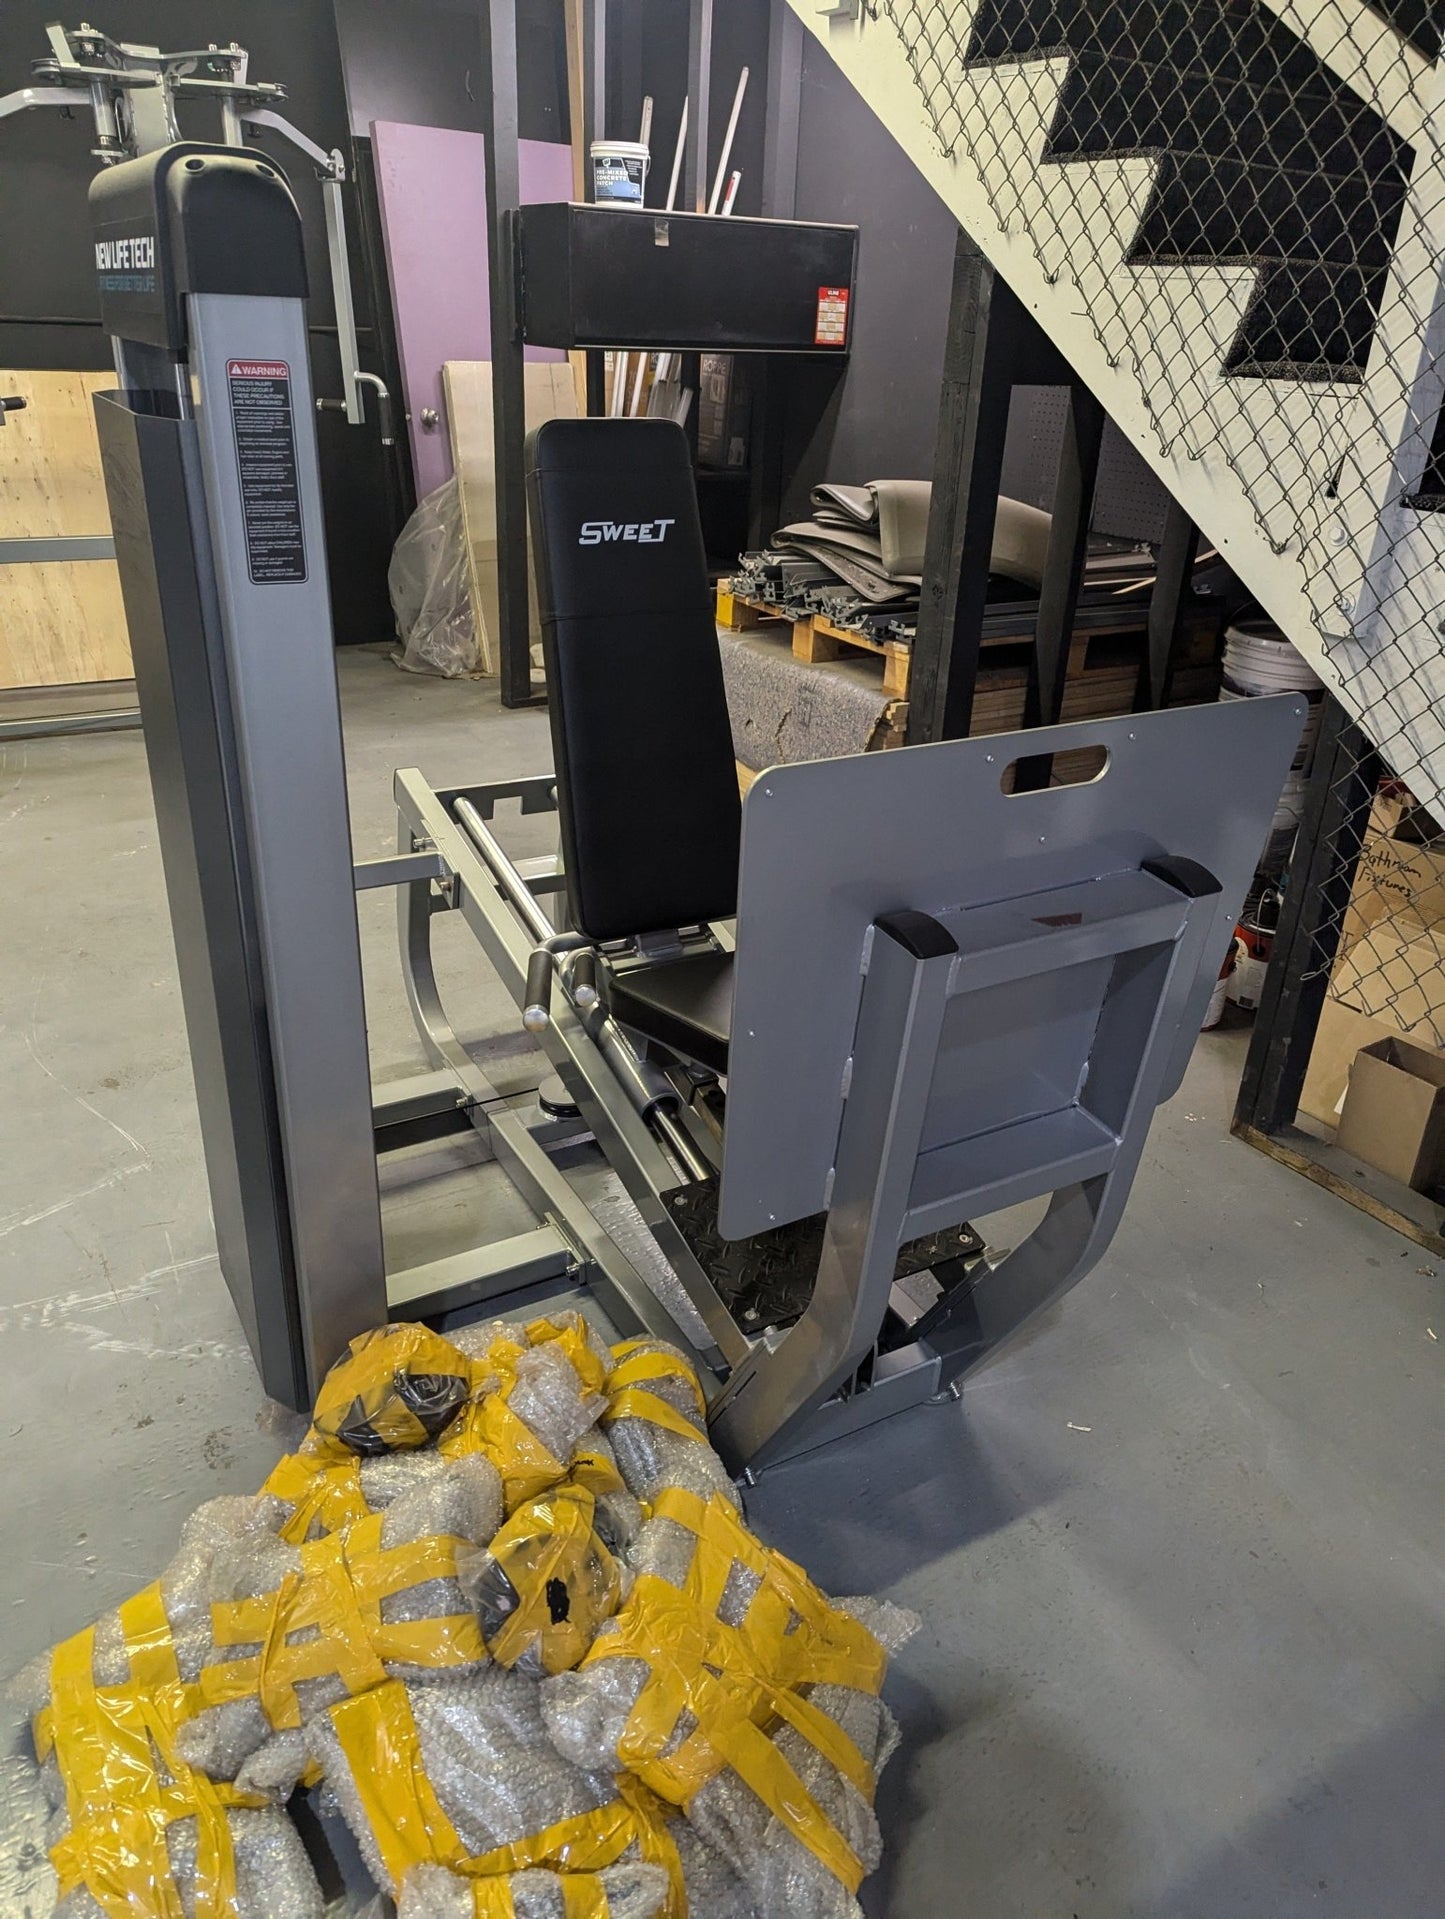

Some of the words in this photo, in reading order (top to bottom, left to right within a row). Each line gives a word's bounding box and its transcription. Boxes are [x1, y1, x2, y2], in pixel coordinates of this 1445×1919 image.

[95, 241, 112, 270] NEW
[112, 239, 130, 269] LIFE
[129, 236, 154, 269] TECH
[241, 366, 287, 376] WARNING
[579, 519, 675, 545] SWEET
